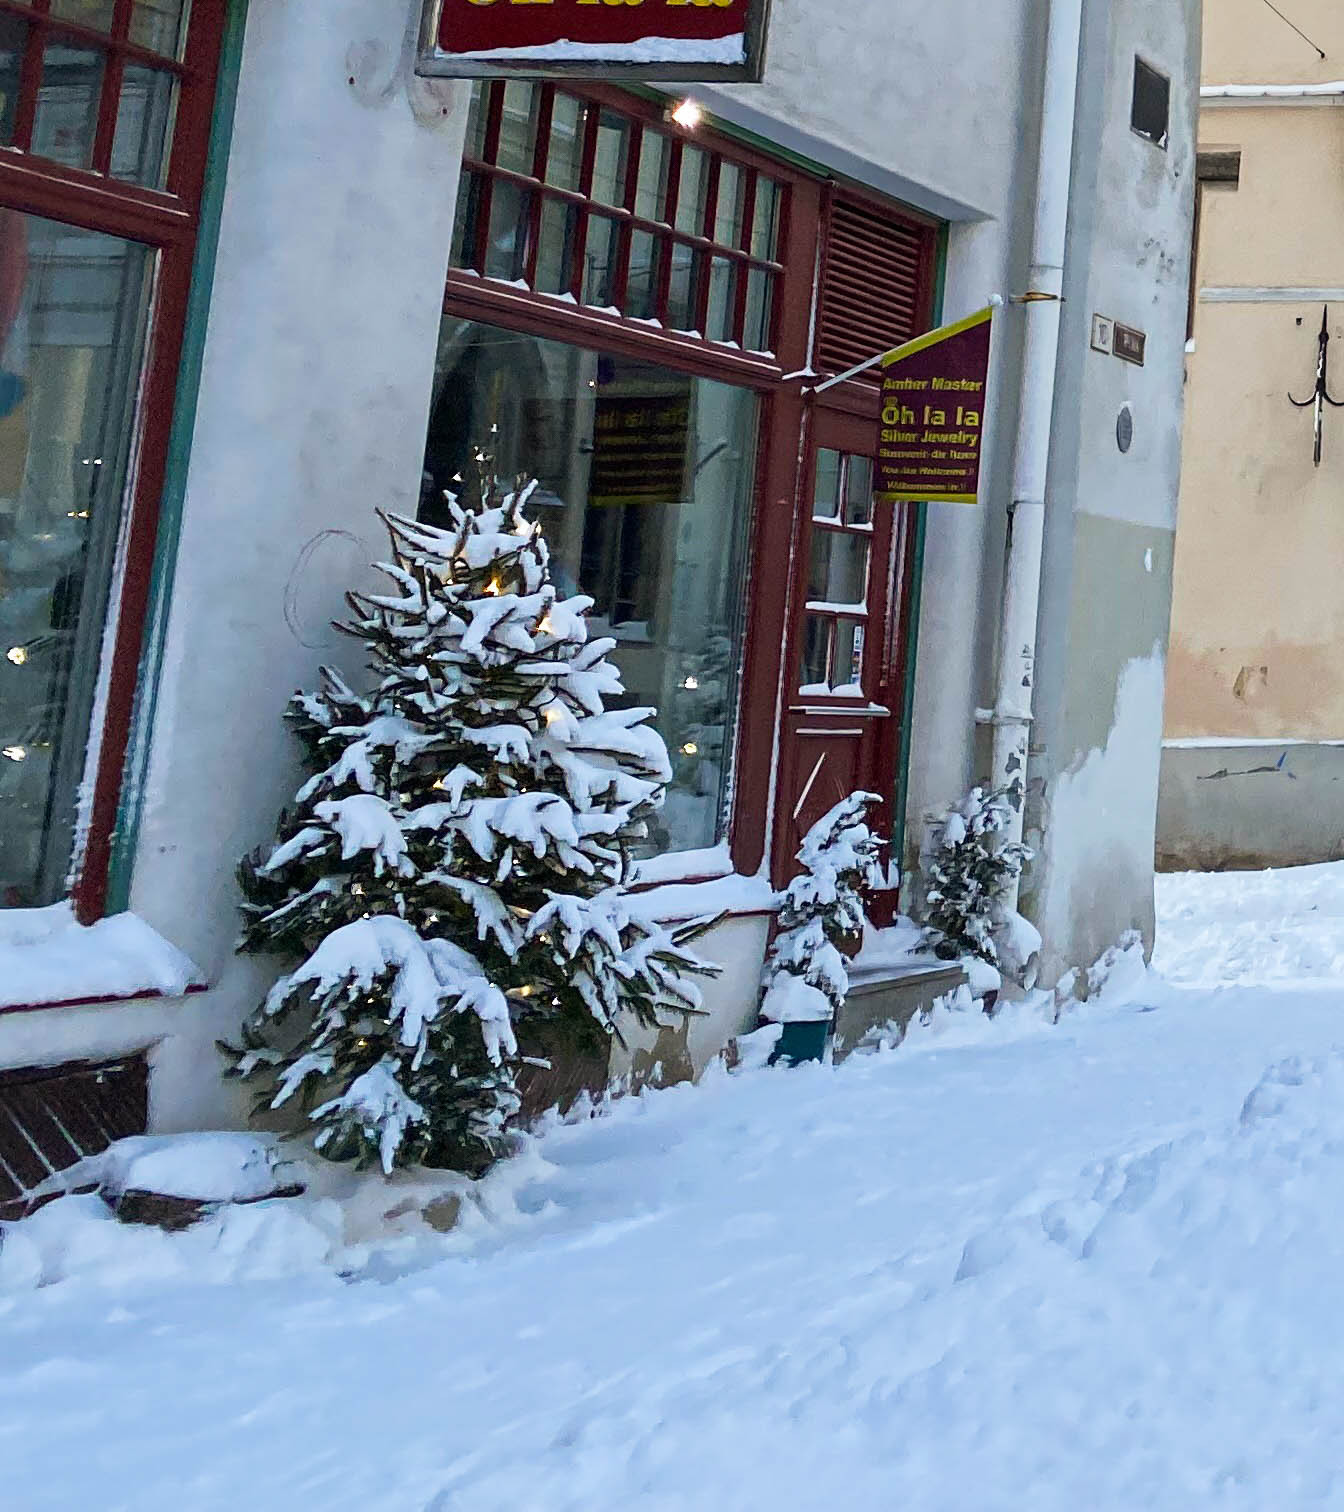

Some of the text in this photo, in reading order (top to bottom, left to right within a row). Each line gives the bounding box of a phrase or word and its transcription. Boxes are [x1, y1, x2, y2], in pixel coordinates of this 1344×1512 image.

[931, 377, 983, 391] Master
[882, 405, 979, 427] Oh la la
